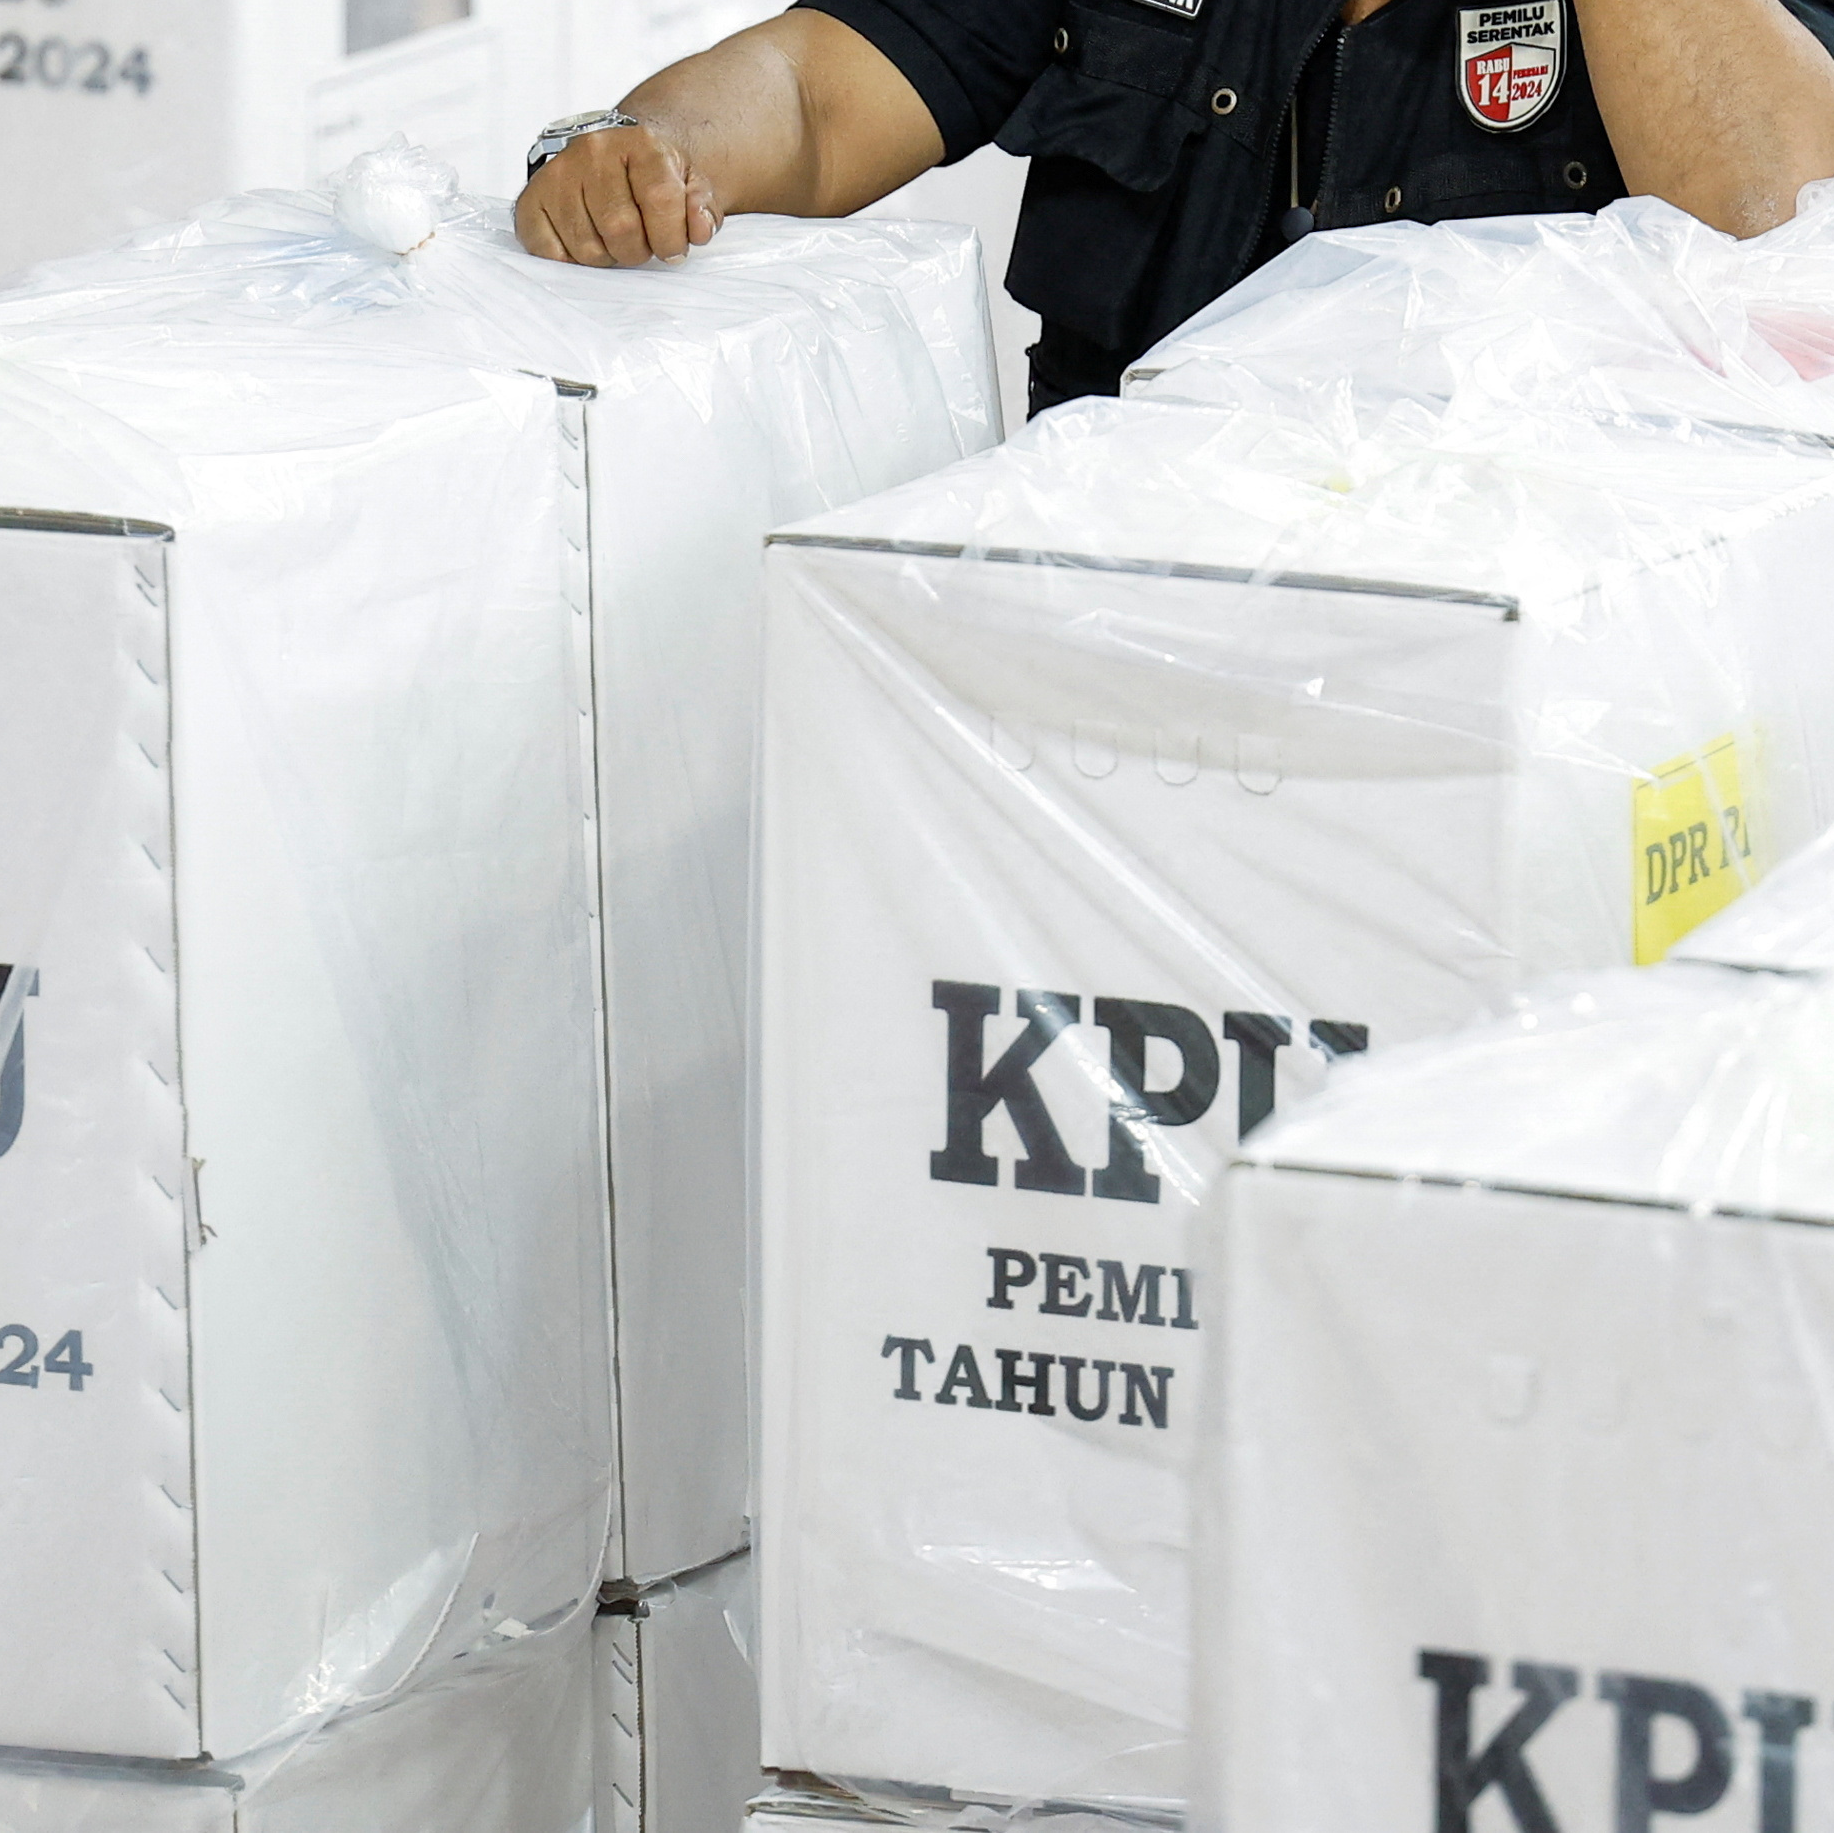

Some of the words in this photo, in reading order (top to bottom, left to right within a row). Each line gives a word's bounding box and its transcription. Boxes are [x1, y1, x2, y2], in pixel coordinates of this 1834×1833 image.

[1479, 5, 1545, 27] PEMILU
[1467, 21, 1555, 44] SERENTAK
[1476, 57, 1510, 75] RABU
[1478, 72, 1509, 106] 14
[1511, 79, 1543, 101] 2024
[1646, 822, 1710, 905] DPR
[881, 1331, 1175, 1429] TAHUN
